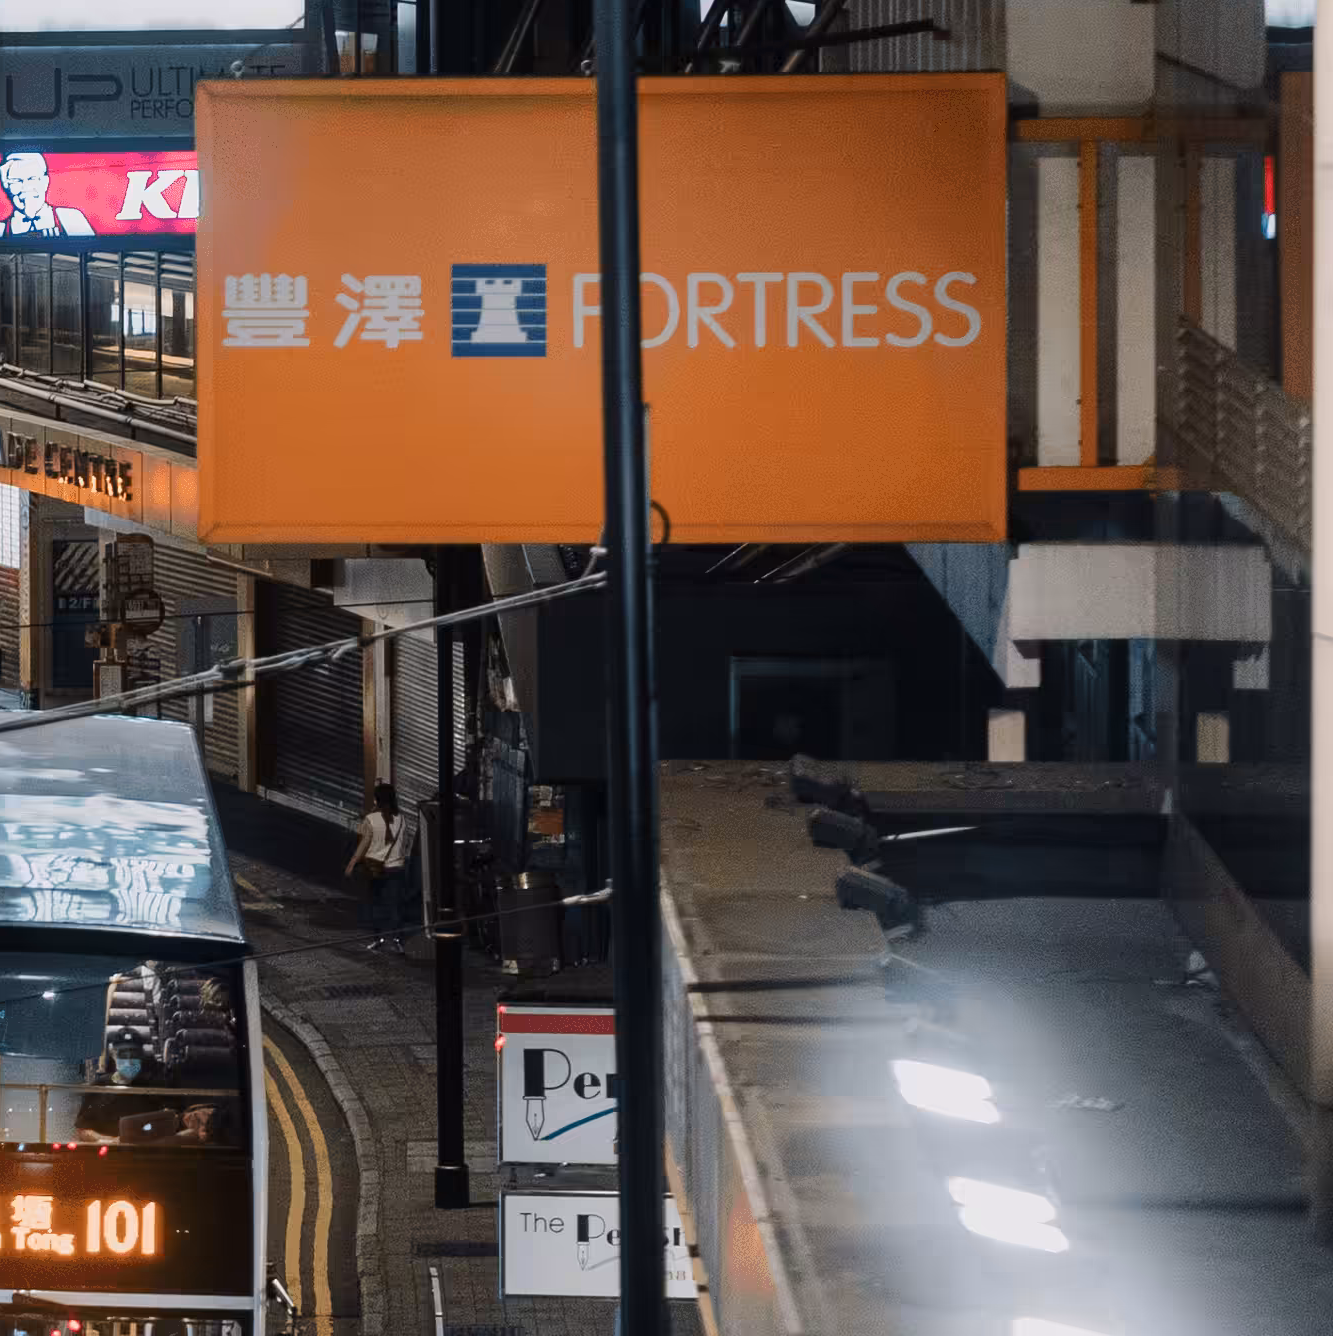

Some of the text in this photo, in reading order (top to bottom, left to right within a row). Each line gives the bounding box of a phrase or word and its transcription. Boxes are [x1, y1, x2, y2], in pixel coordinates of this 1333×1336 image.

[6, 67, 123, 120] UP
[130, 100, 196, 119] PERFO
[222, 272, 426, 351] 豐澤
[572, 271, 982, 349] FORTRESS
[10, 1225, 76, 1256] Tong
[85, 1199, 156, 1256] 101
[519, 1212, 565, 1233] The
